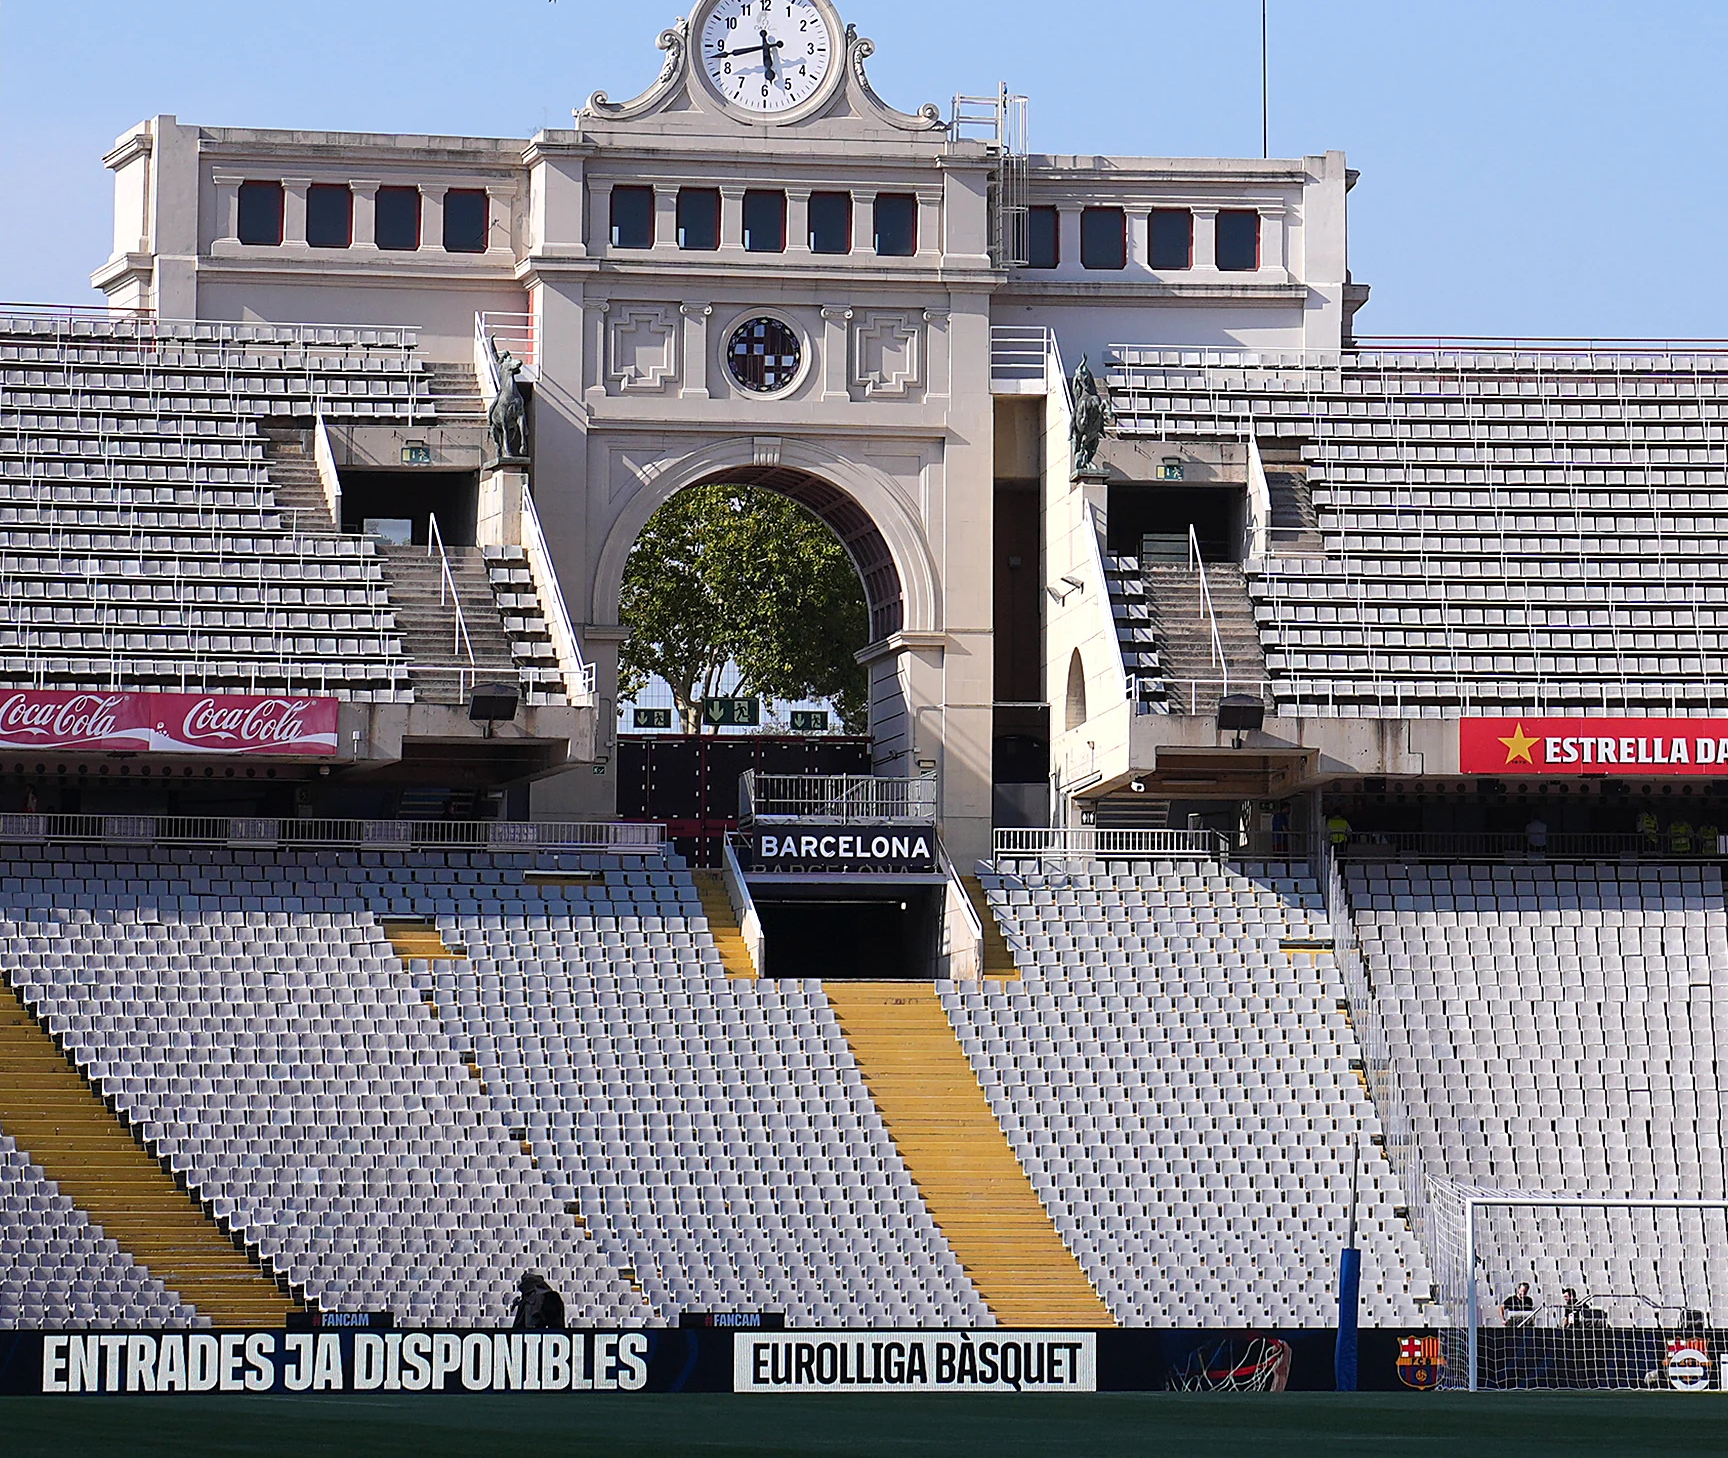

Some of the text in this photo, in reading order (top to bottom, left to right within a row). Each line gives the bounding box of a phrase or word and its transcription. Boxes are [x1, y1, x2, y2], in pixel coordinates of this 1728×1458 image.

[741, 4, 751, 16] 11
[761, 0, 772, 11] 12
[725, 17, 737, 29] 10
[799, 20, 807, 31] 2
[717, 39, 724, 51] 9
[807, 43, 814, 54] 3
[724, 62, 731, 74] 8
[798, 65, 806, 76] 4
[738, 77, 745, 88] 7
[785, 78, 792, 90] 5
[761, 85, 768, 97] 6
[183, 698, 313, 741] Coca-Cola
[1545, 736, 1690, 765] ESTRELLA
[761, 835, 931, 858] BARCELONA
[42, 1332, 648, 1392] ENTRADES JA DISPONIBLES
[752, 1332, 1082, 1392] EUROLLIGA BÀSQUET
